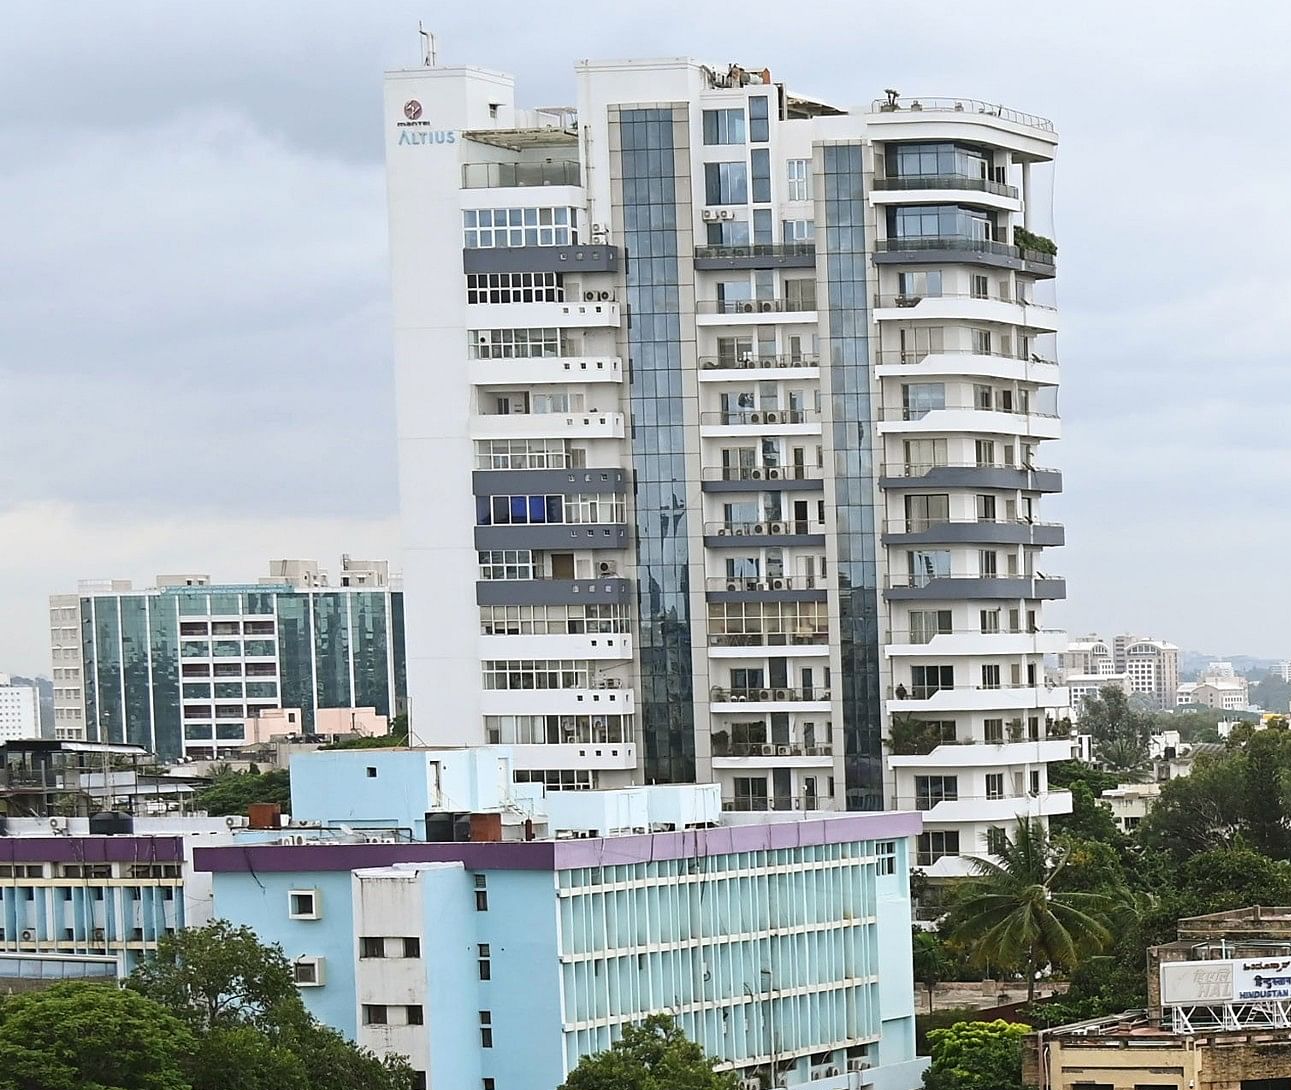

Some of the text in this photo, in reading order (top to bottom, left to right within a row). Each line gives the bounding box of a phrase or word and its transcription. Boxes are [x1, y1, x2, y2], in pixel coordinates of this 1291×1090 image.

[398, 130, 455, 145] ALTIUS
[1199, 984, 1232, 998] HAL
[1239, 990, 1289, 999] HINDUSTAN
